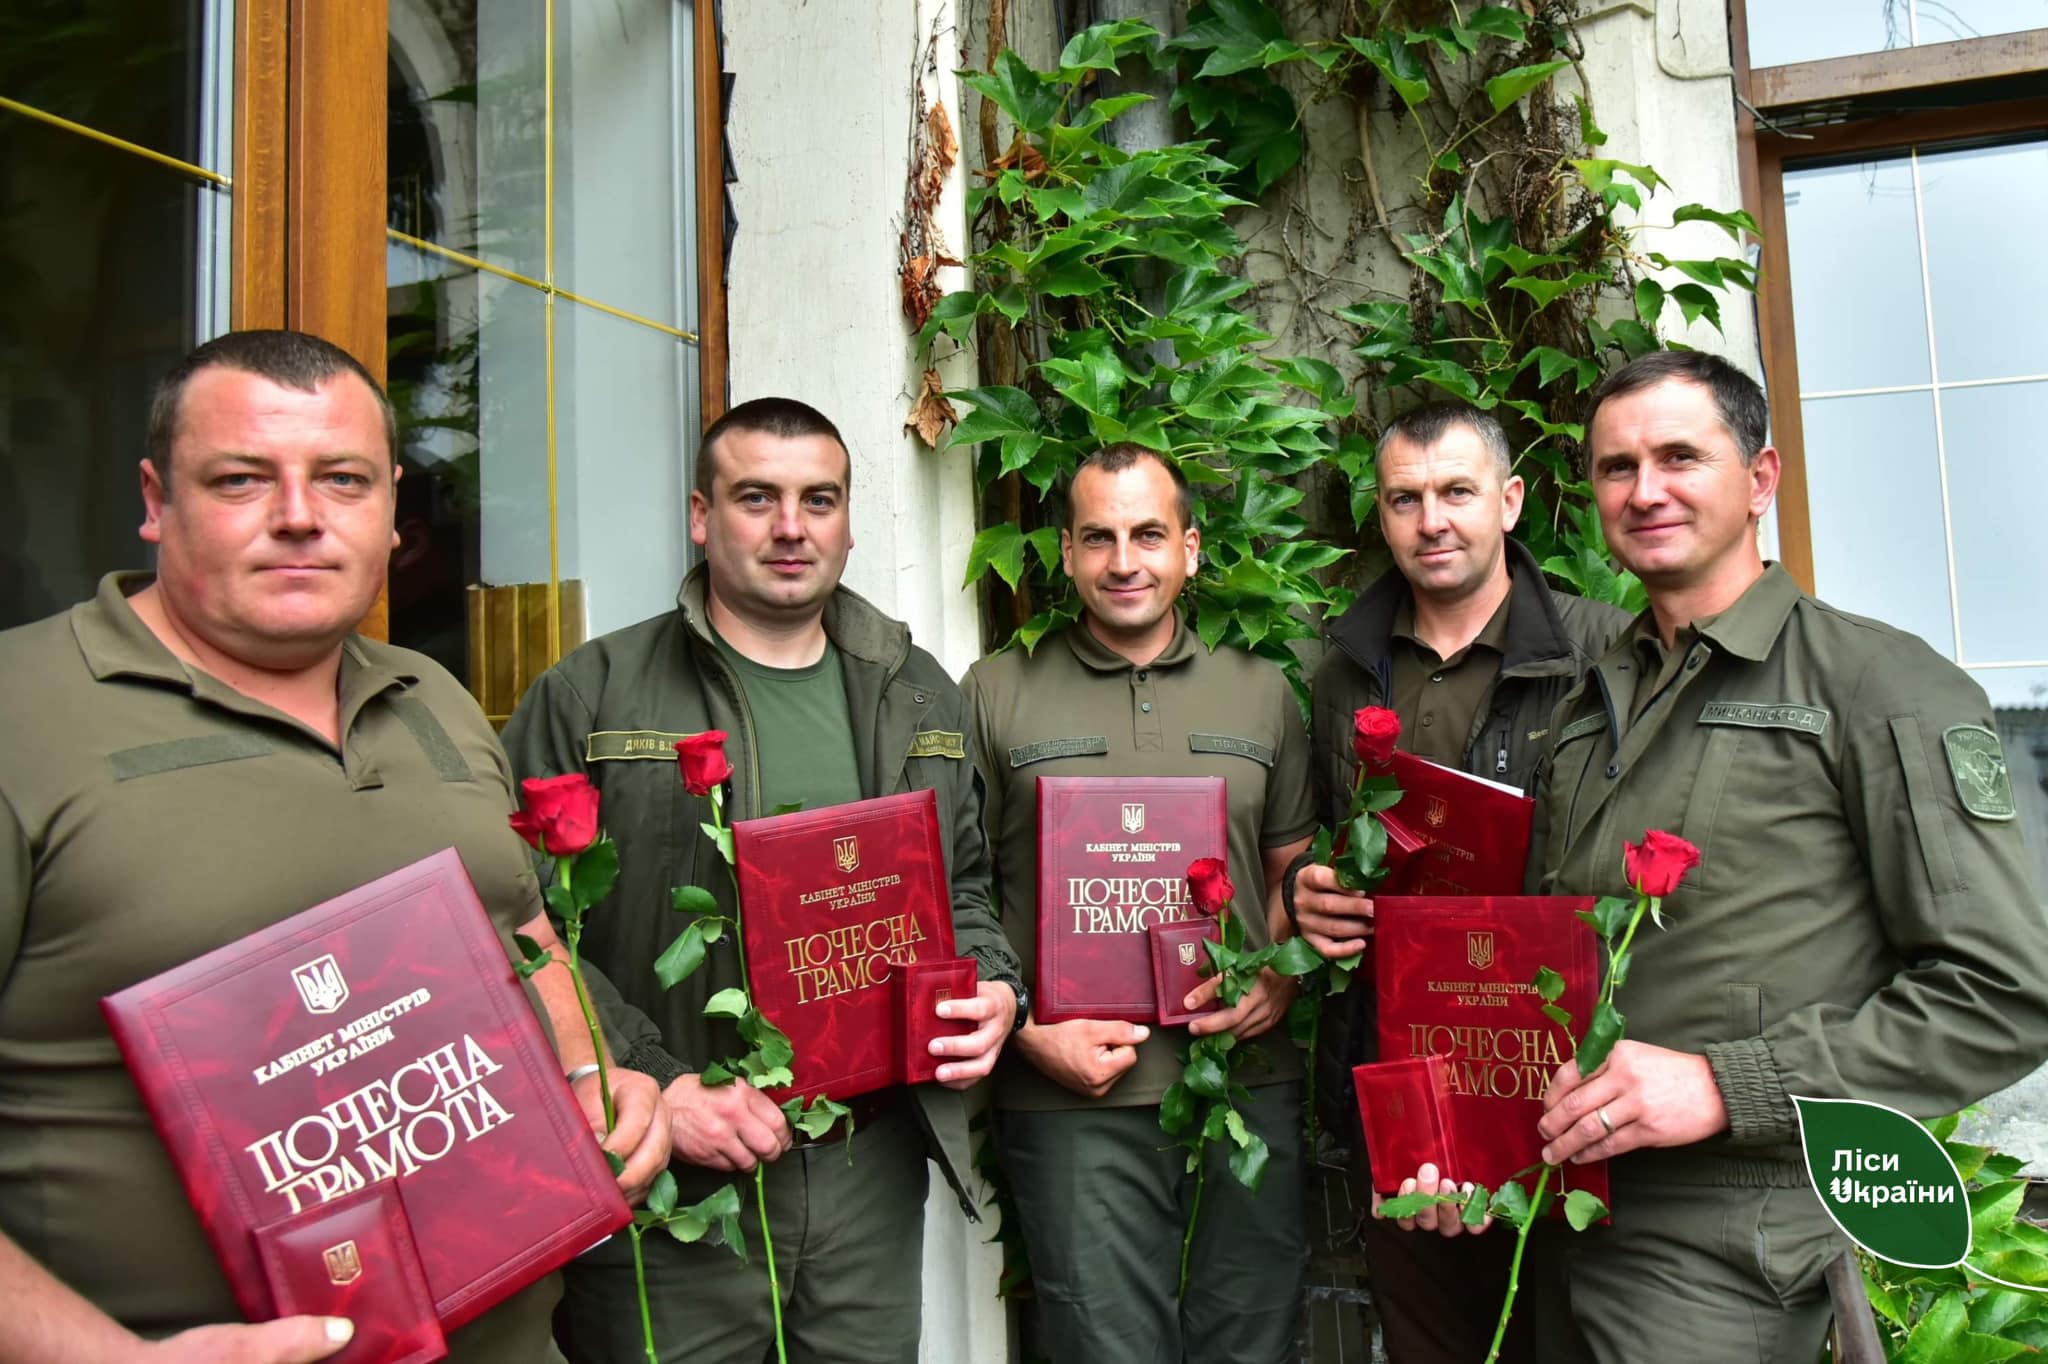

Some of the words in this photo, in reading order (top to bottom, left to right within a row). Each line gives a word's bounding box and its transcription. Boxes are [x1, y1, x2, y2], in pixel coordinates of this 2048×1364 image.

[624, 738, 656, 753] ДЯКІВ
[1085, 843, 1129, 853] КАБІНЕТ
[1130, 842, 1181, 853] МІНІСТРІВ
[1111, 852, 1156, 863] УКРАЇНИ
[799, 886, 846, 905] КАБІНЕТ
[847, 873, 901, 895] МІНІСТРІВ
[829, 891, 877, 911] УКРАЇНИ
[784, 911, 928, 973] ПОЧЕСНА
[1427, 981, 1476, 993] КАБІНЕТ
[1478, 983, 1539, 995] МІНІСТРІВ
[1456, 994, 1509, 1007] УКРАЇНИ
[253, 1033, 336, 1086] КАБІНЕТ
[337, 987, 432, 1044] МІНІСТРІВ
[310, 1025, 396, 1078] УКРАЇНИ
[1408, 1023, 1565, 1065] ПОЧЕСНА
[244, 1033, 504, 1193] ПОЧЕСНА
[277, 1082, 515, 1215] ГРАМОТА
